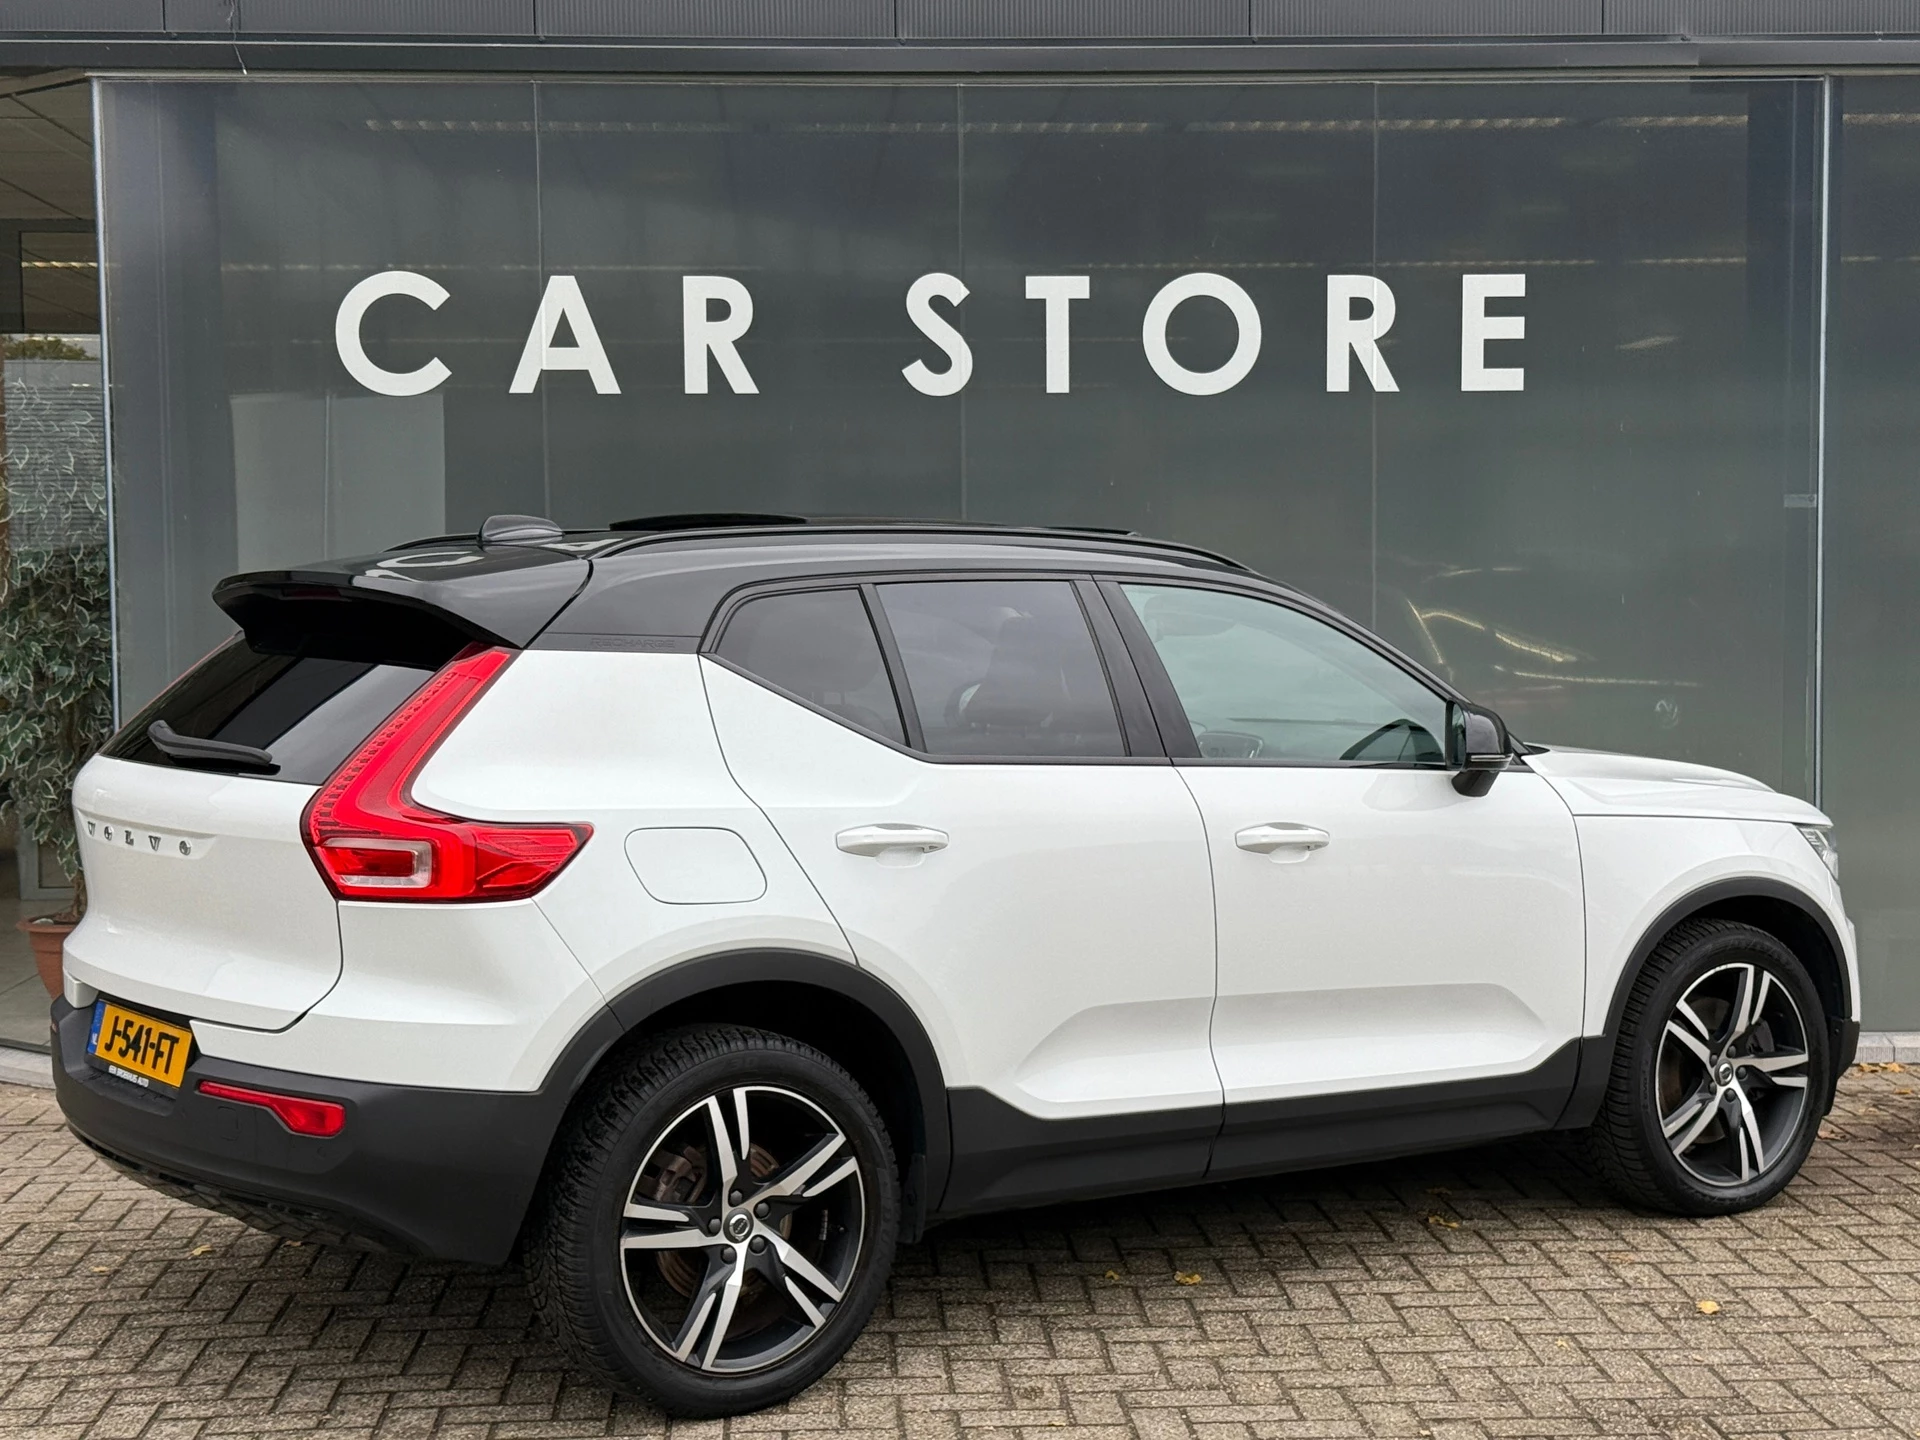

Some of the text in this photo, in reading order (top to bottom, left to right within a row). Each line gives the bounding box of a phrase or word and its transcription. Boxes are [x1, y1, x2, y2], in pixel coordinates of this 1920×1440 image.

[335, 270, 1526, 398] CAR STORE
[590, 637, 676, 649] RECHARGE
[87, 820, 192, 856] VOLVO
[104, 1015, 180, 1075] J-541-FT
